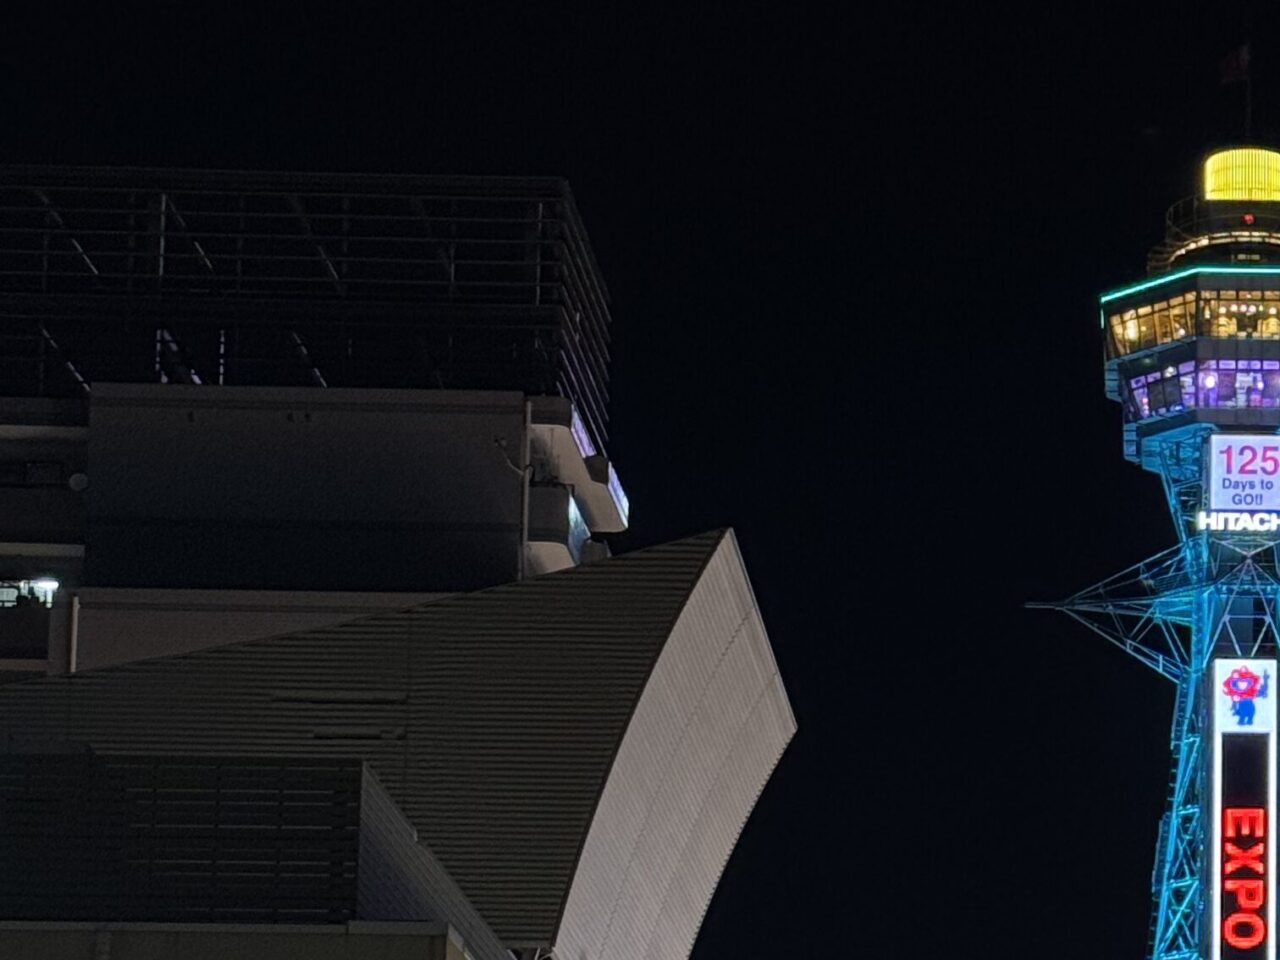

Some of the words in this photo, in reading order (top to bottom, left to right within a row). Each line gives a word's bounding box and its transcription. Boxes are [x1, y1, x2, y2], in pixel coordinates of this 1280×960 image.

[1219, 445, 1280, 475] 125
[1222, 478, 1255, 492] Days
[1261, 479, 1273, 489] to
[1223, 807, 1265, 949] EXPO
